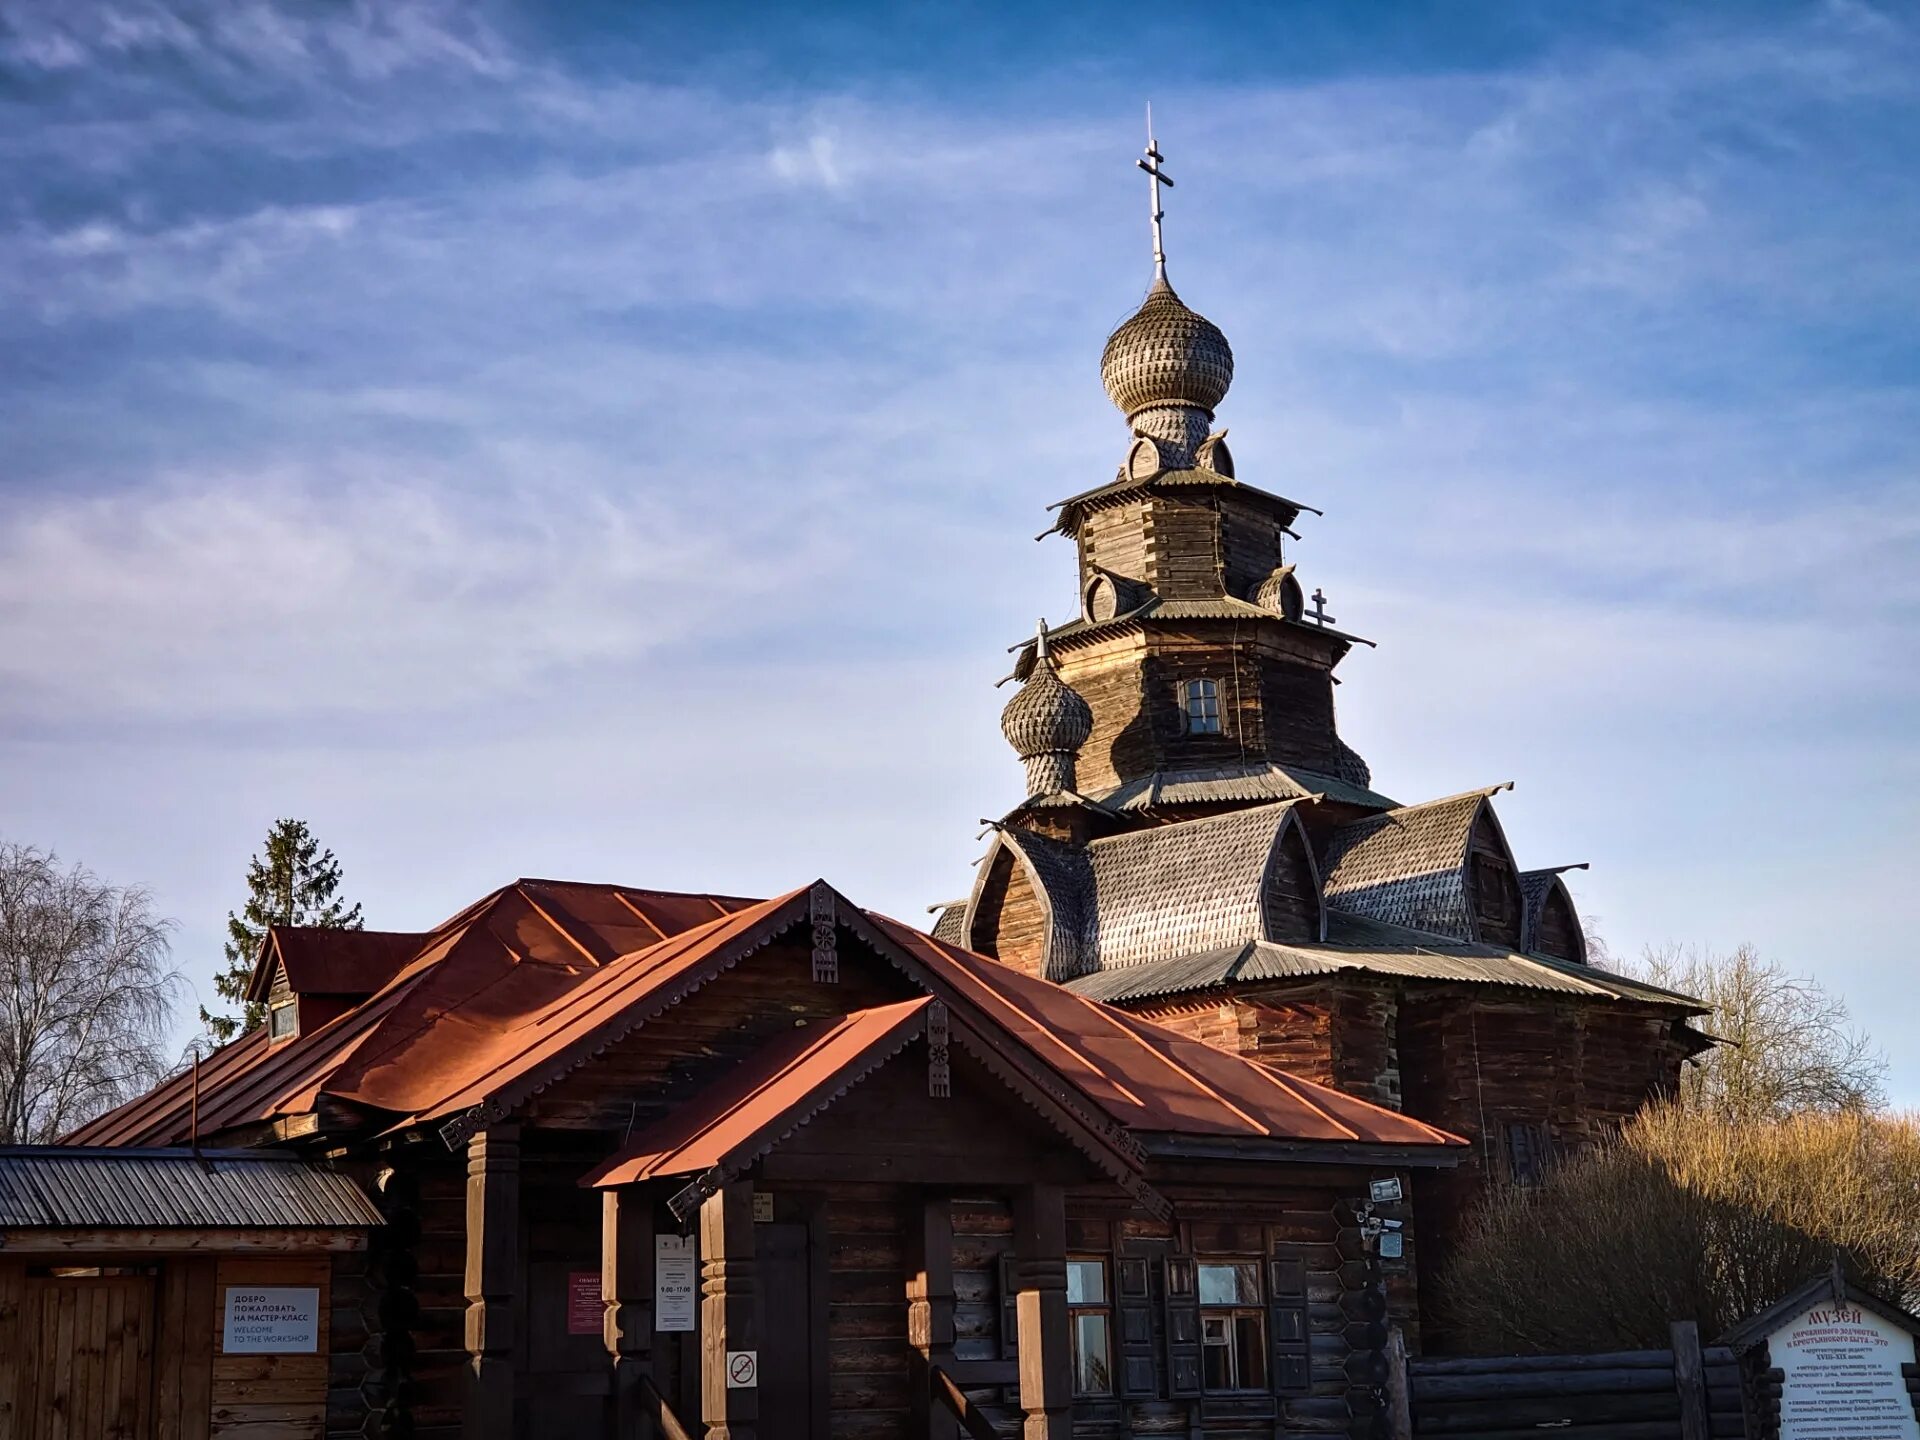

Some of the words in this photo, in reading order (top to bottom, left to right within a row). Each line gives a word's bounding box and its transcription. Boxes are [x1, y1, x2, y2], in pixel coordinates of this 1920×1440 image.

[234, 1295, 266, 1303] ДОБРО
[1808, 1309, 1862, 1326] МУЗЕЙ
[233, 1326, 273, 1334] WELCOME
[247, 1335, 262, 1343] THE
[263, 1334, 309, 1343] WORKSHOP
